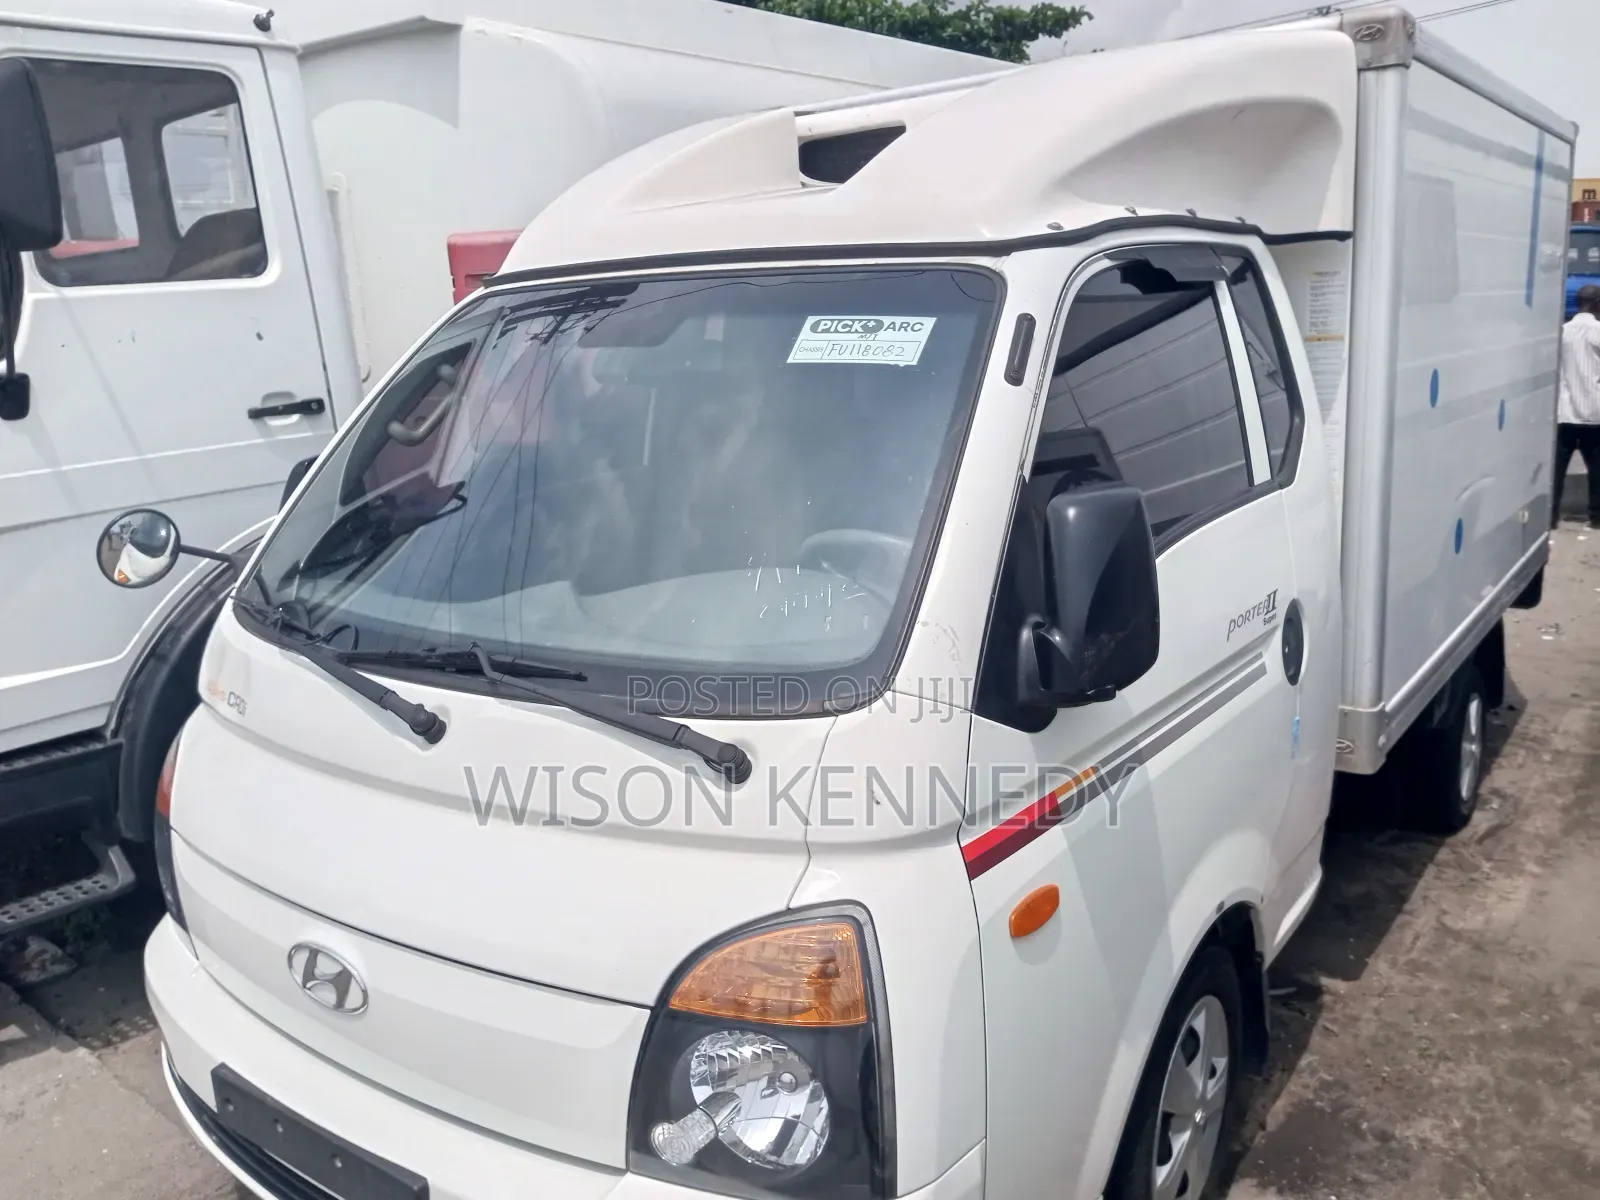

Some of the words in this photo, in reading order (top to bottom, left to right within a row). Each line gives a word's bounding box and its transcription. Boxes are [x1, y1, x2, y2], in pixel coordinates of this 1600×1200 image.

[883, 321, 925, 332] ARC
[1226, 598, 1270, 642] PORTER
[1263, 613, 1277, 626] Super
